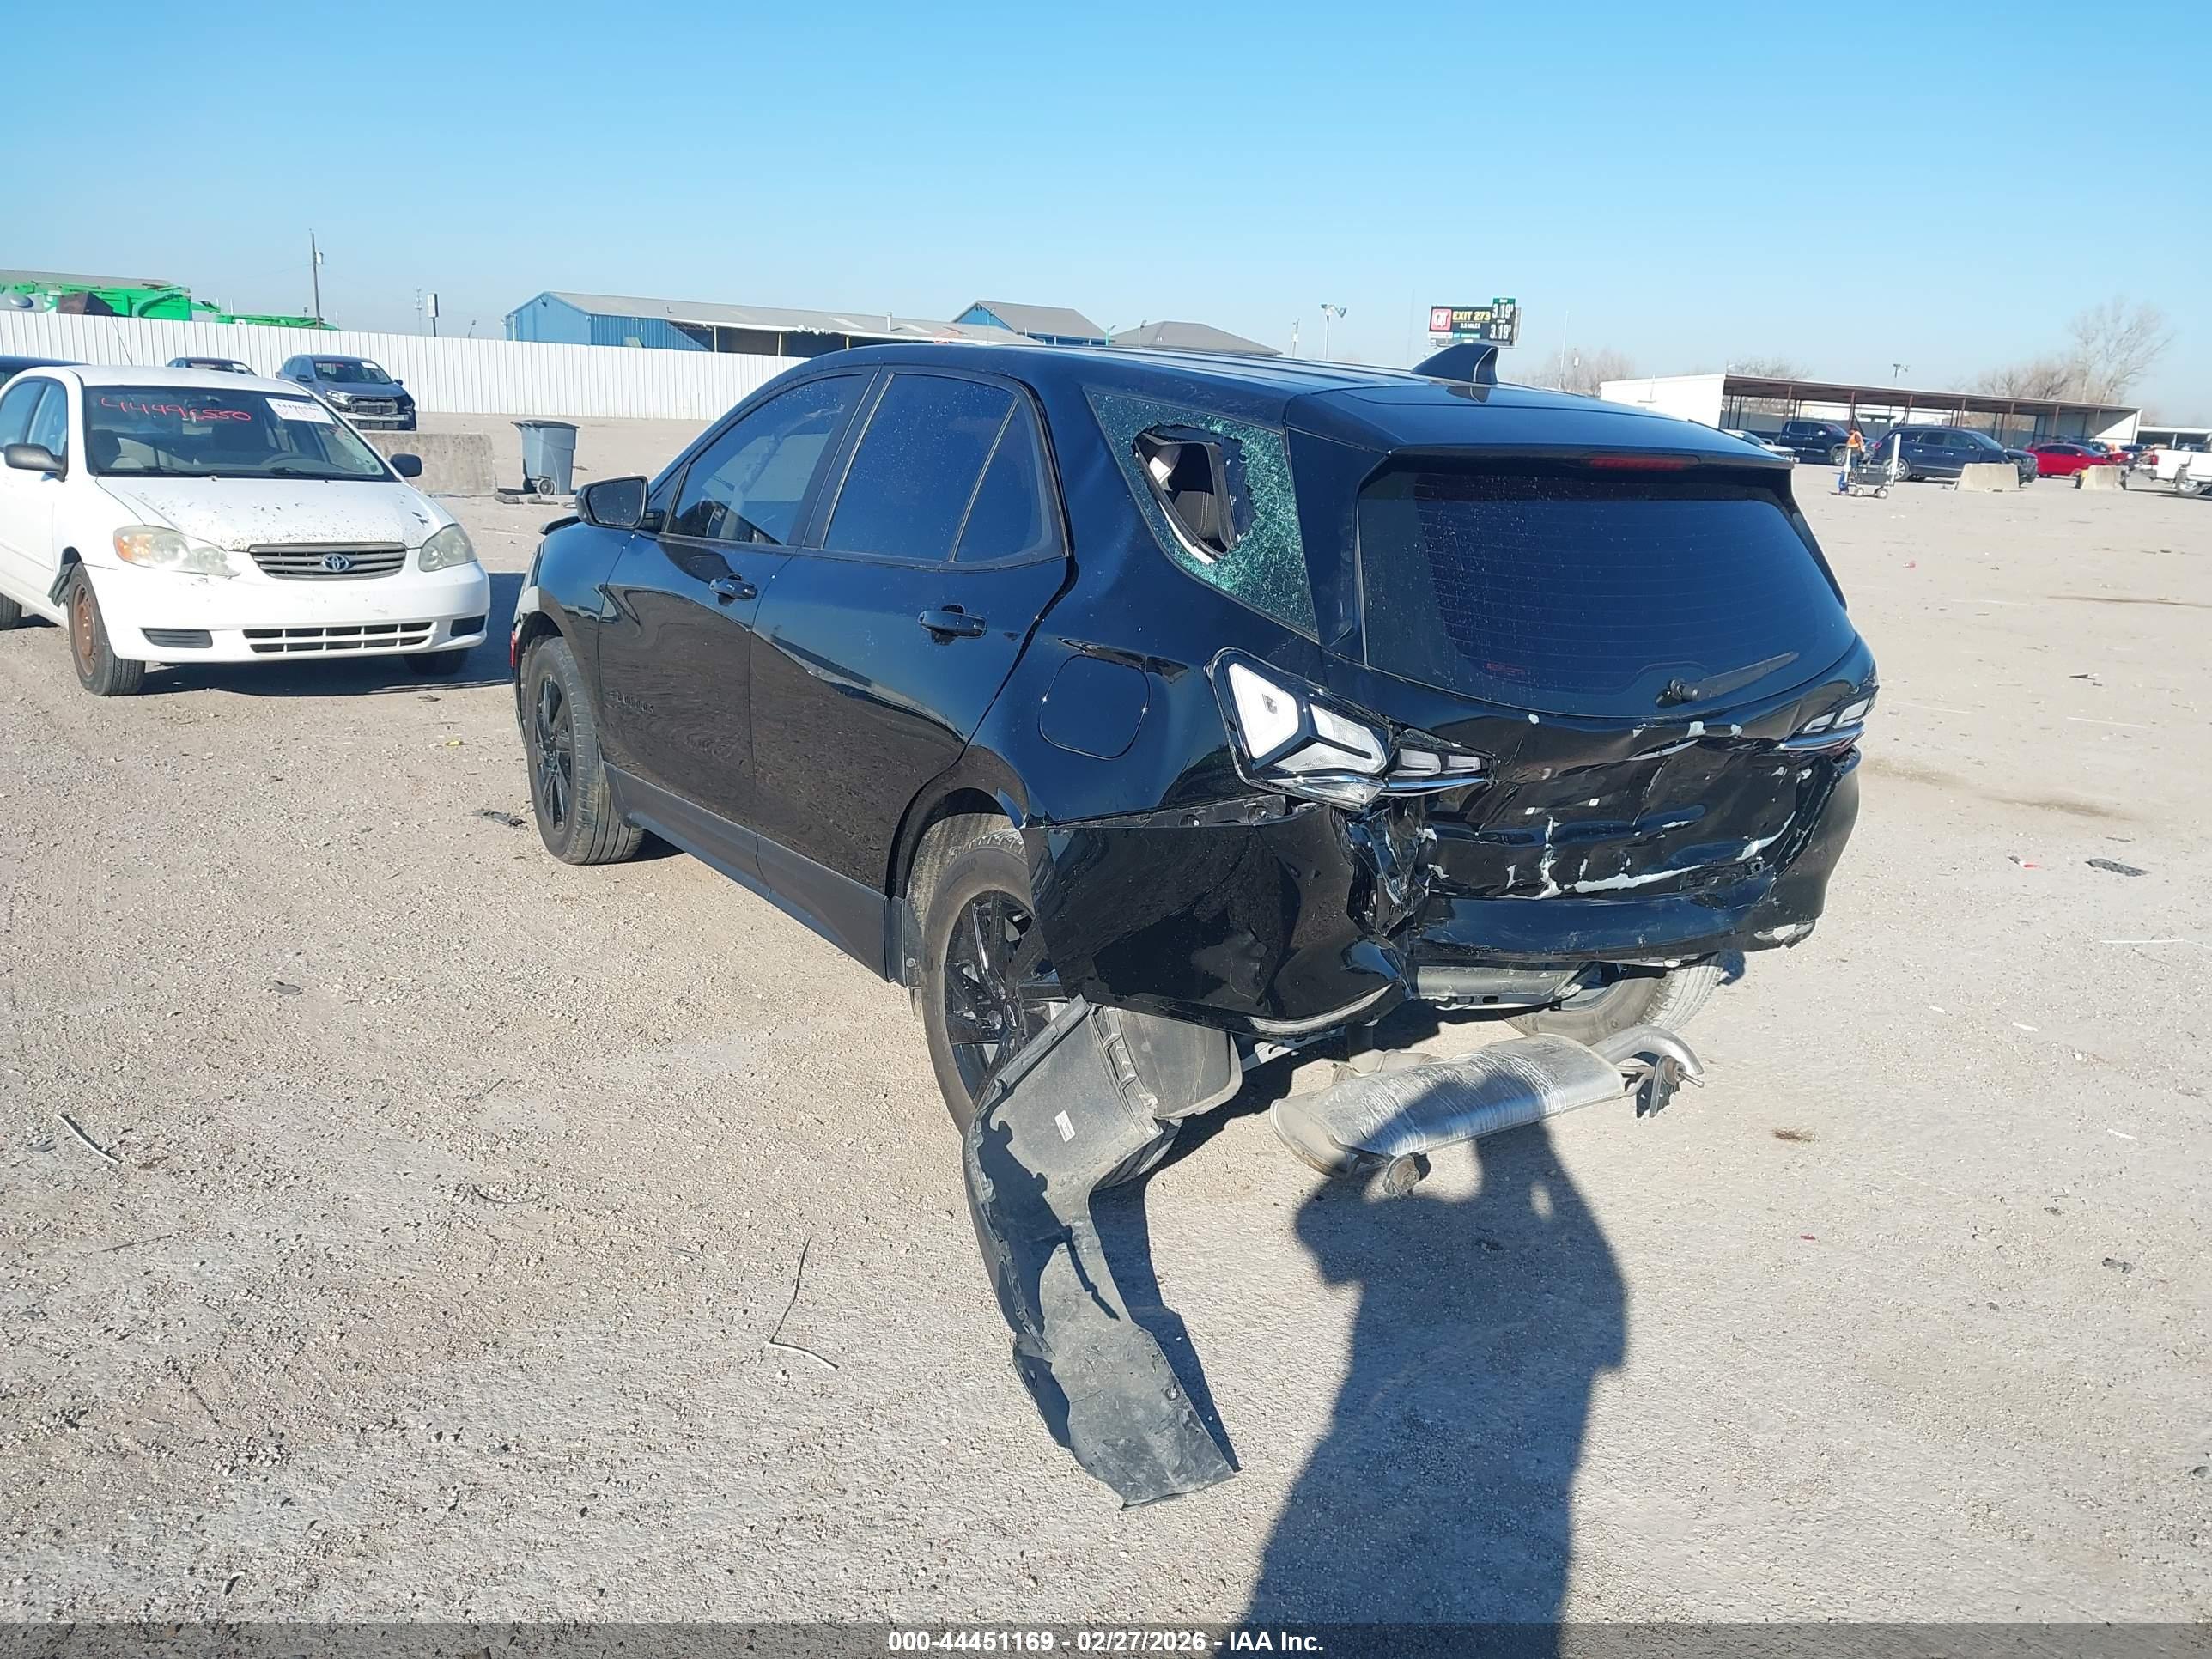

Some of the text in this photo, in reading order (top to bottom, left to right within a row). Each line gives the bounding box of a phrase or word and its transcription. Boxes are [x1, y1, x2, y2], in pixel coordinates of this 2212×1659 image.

[1433, 311, 1449, 327] QT
[1452, 311, 1473, 321] EXIT
[1474, 311, 1491, 321] 273
